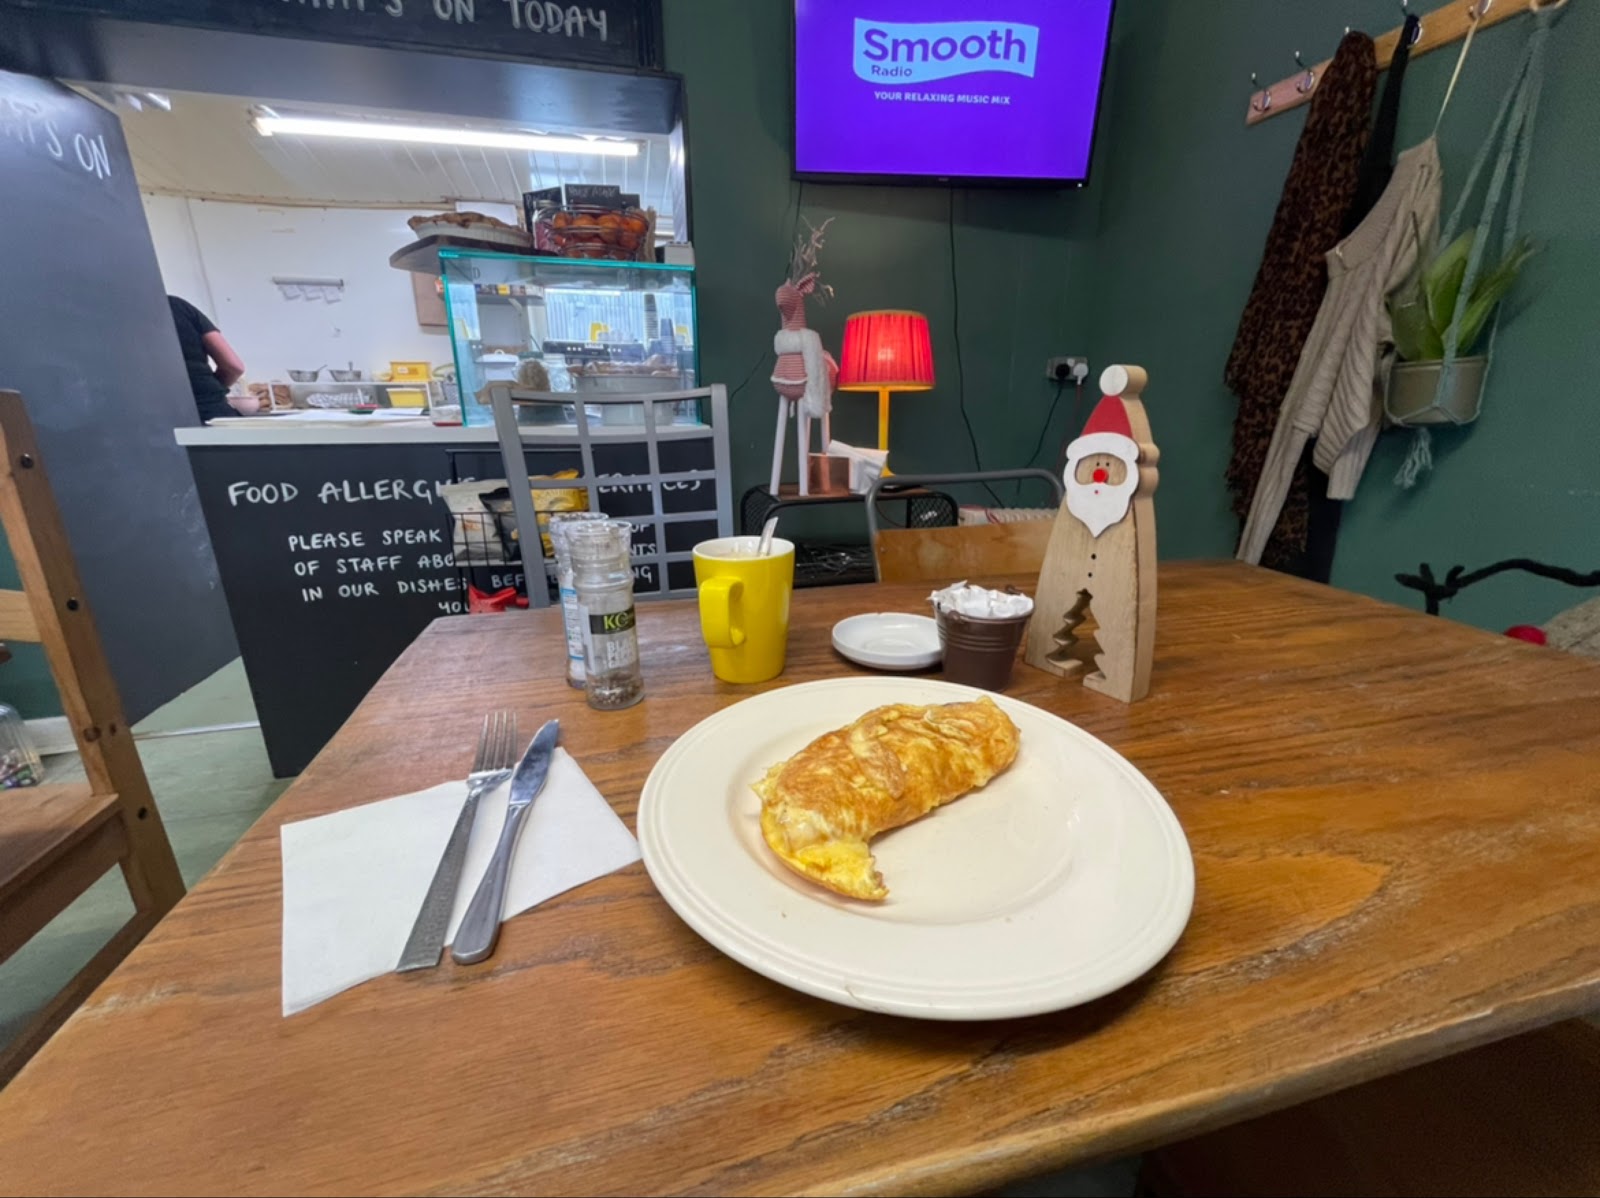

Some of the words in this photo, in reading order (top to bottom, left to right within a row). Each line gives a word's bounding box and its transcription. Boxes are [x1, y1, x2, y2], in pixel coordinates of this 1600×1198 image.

[509, 0, 607, 41] TODAY
[862, 27, 1027, 64] Smooth
[870, 64, 913, 78] Radio
[873, 90, 903, 101] YOUR
[904, 91, 955, 103] RELAXING
[956, 94, 990, 104] MUSIC
[990, 95, 1011, 105] MIX
[74, 132, 112, 180] ON
[227, 481, 299, 506] FOOD
[287, 531, 366, 552] PLEASE
[381, 528, 443, 546] SPEAK
[293, 559, 320, 576] OF
[336, 555, 402, 574] STAFF
[416, 551, 454, 569] ABO
[301, 586, 324, 602] IN
[338, 581, 380, 598] OUR
[396, 577, 468, 594] DISHES
